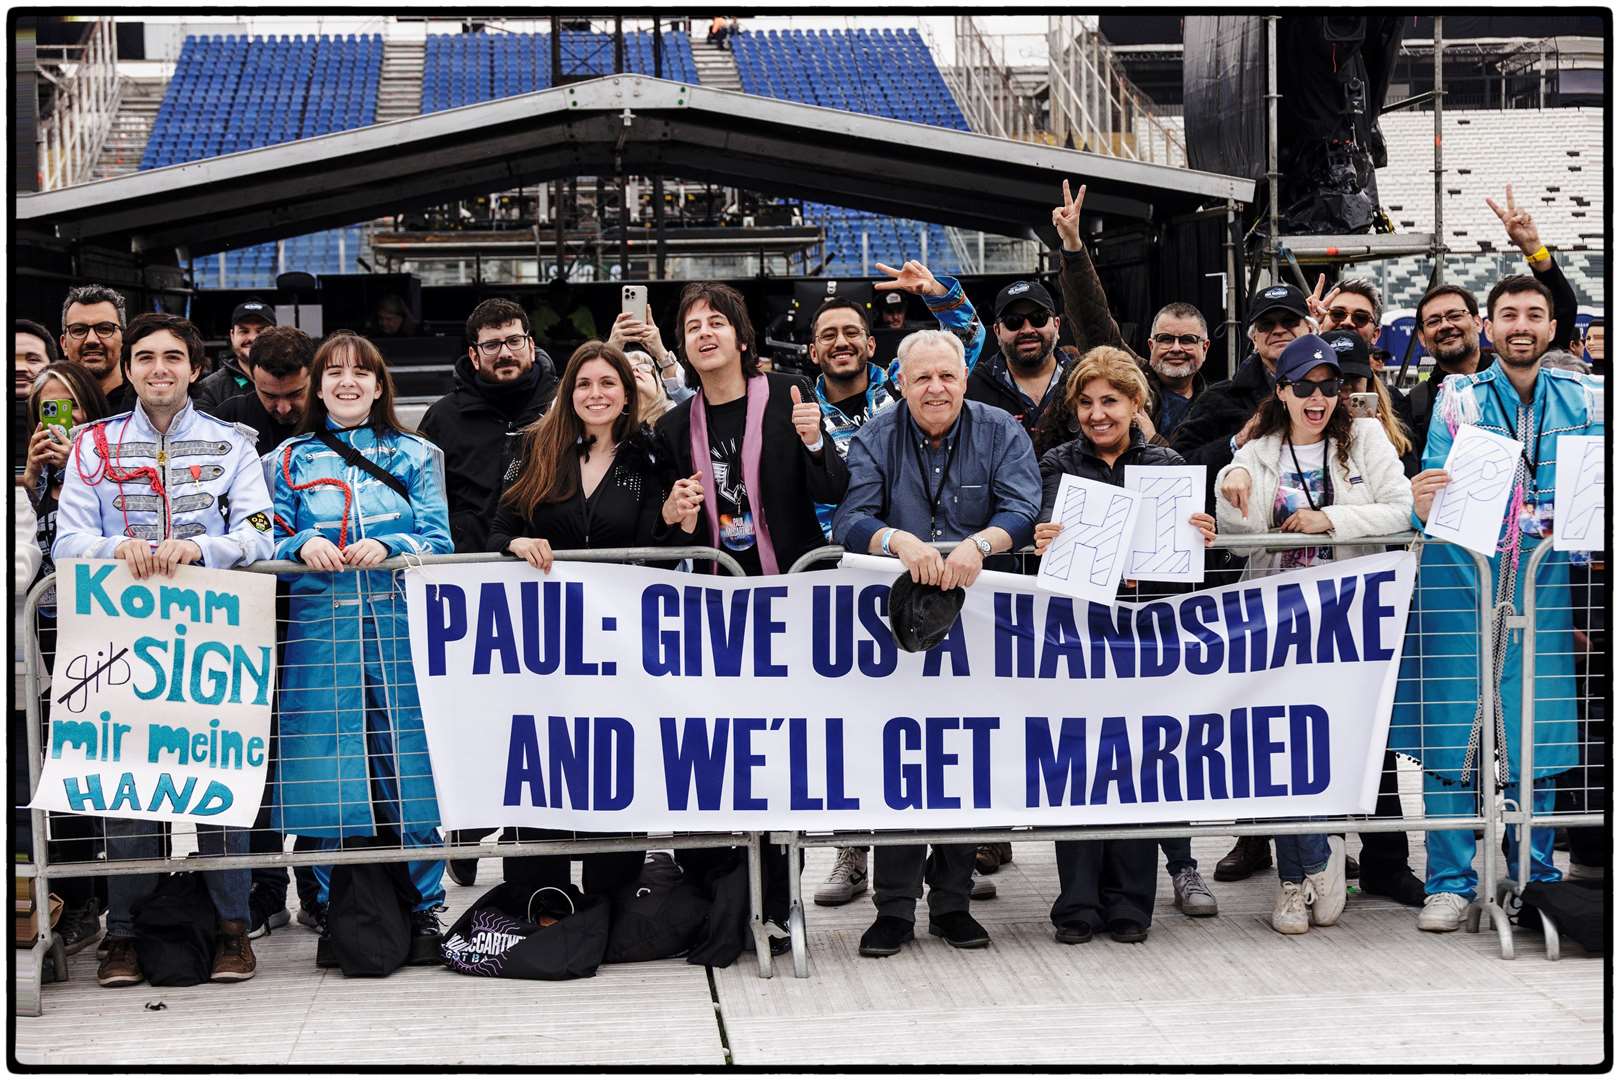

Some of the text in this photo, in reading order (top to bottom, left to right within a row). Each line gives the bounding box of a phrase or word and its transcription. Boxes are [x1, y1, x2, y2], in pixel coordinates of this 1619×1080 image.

[75, 564, 240, 626] Komm
[426, 570, 1396, 679] PAUL: GIVE US A HANDSHAKE
[64, 641, 131, 713] gib
[52, 711, 265, 769] mir meine
[503, 714, 635, 811] AND
[882, 716, 1000, 811] GET
[1025, 704, 1331, 808] MARRIED
[63, 772, 234, 816] HAND
